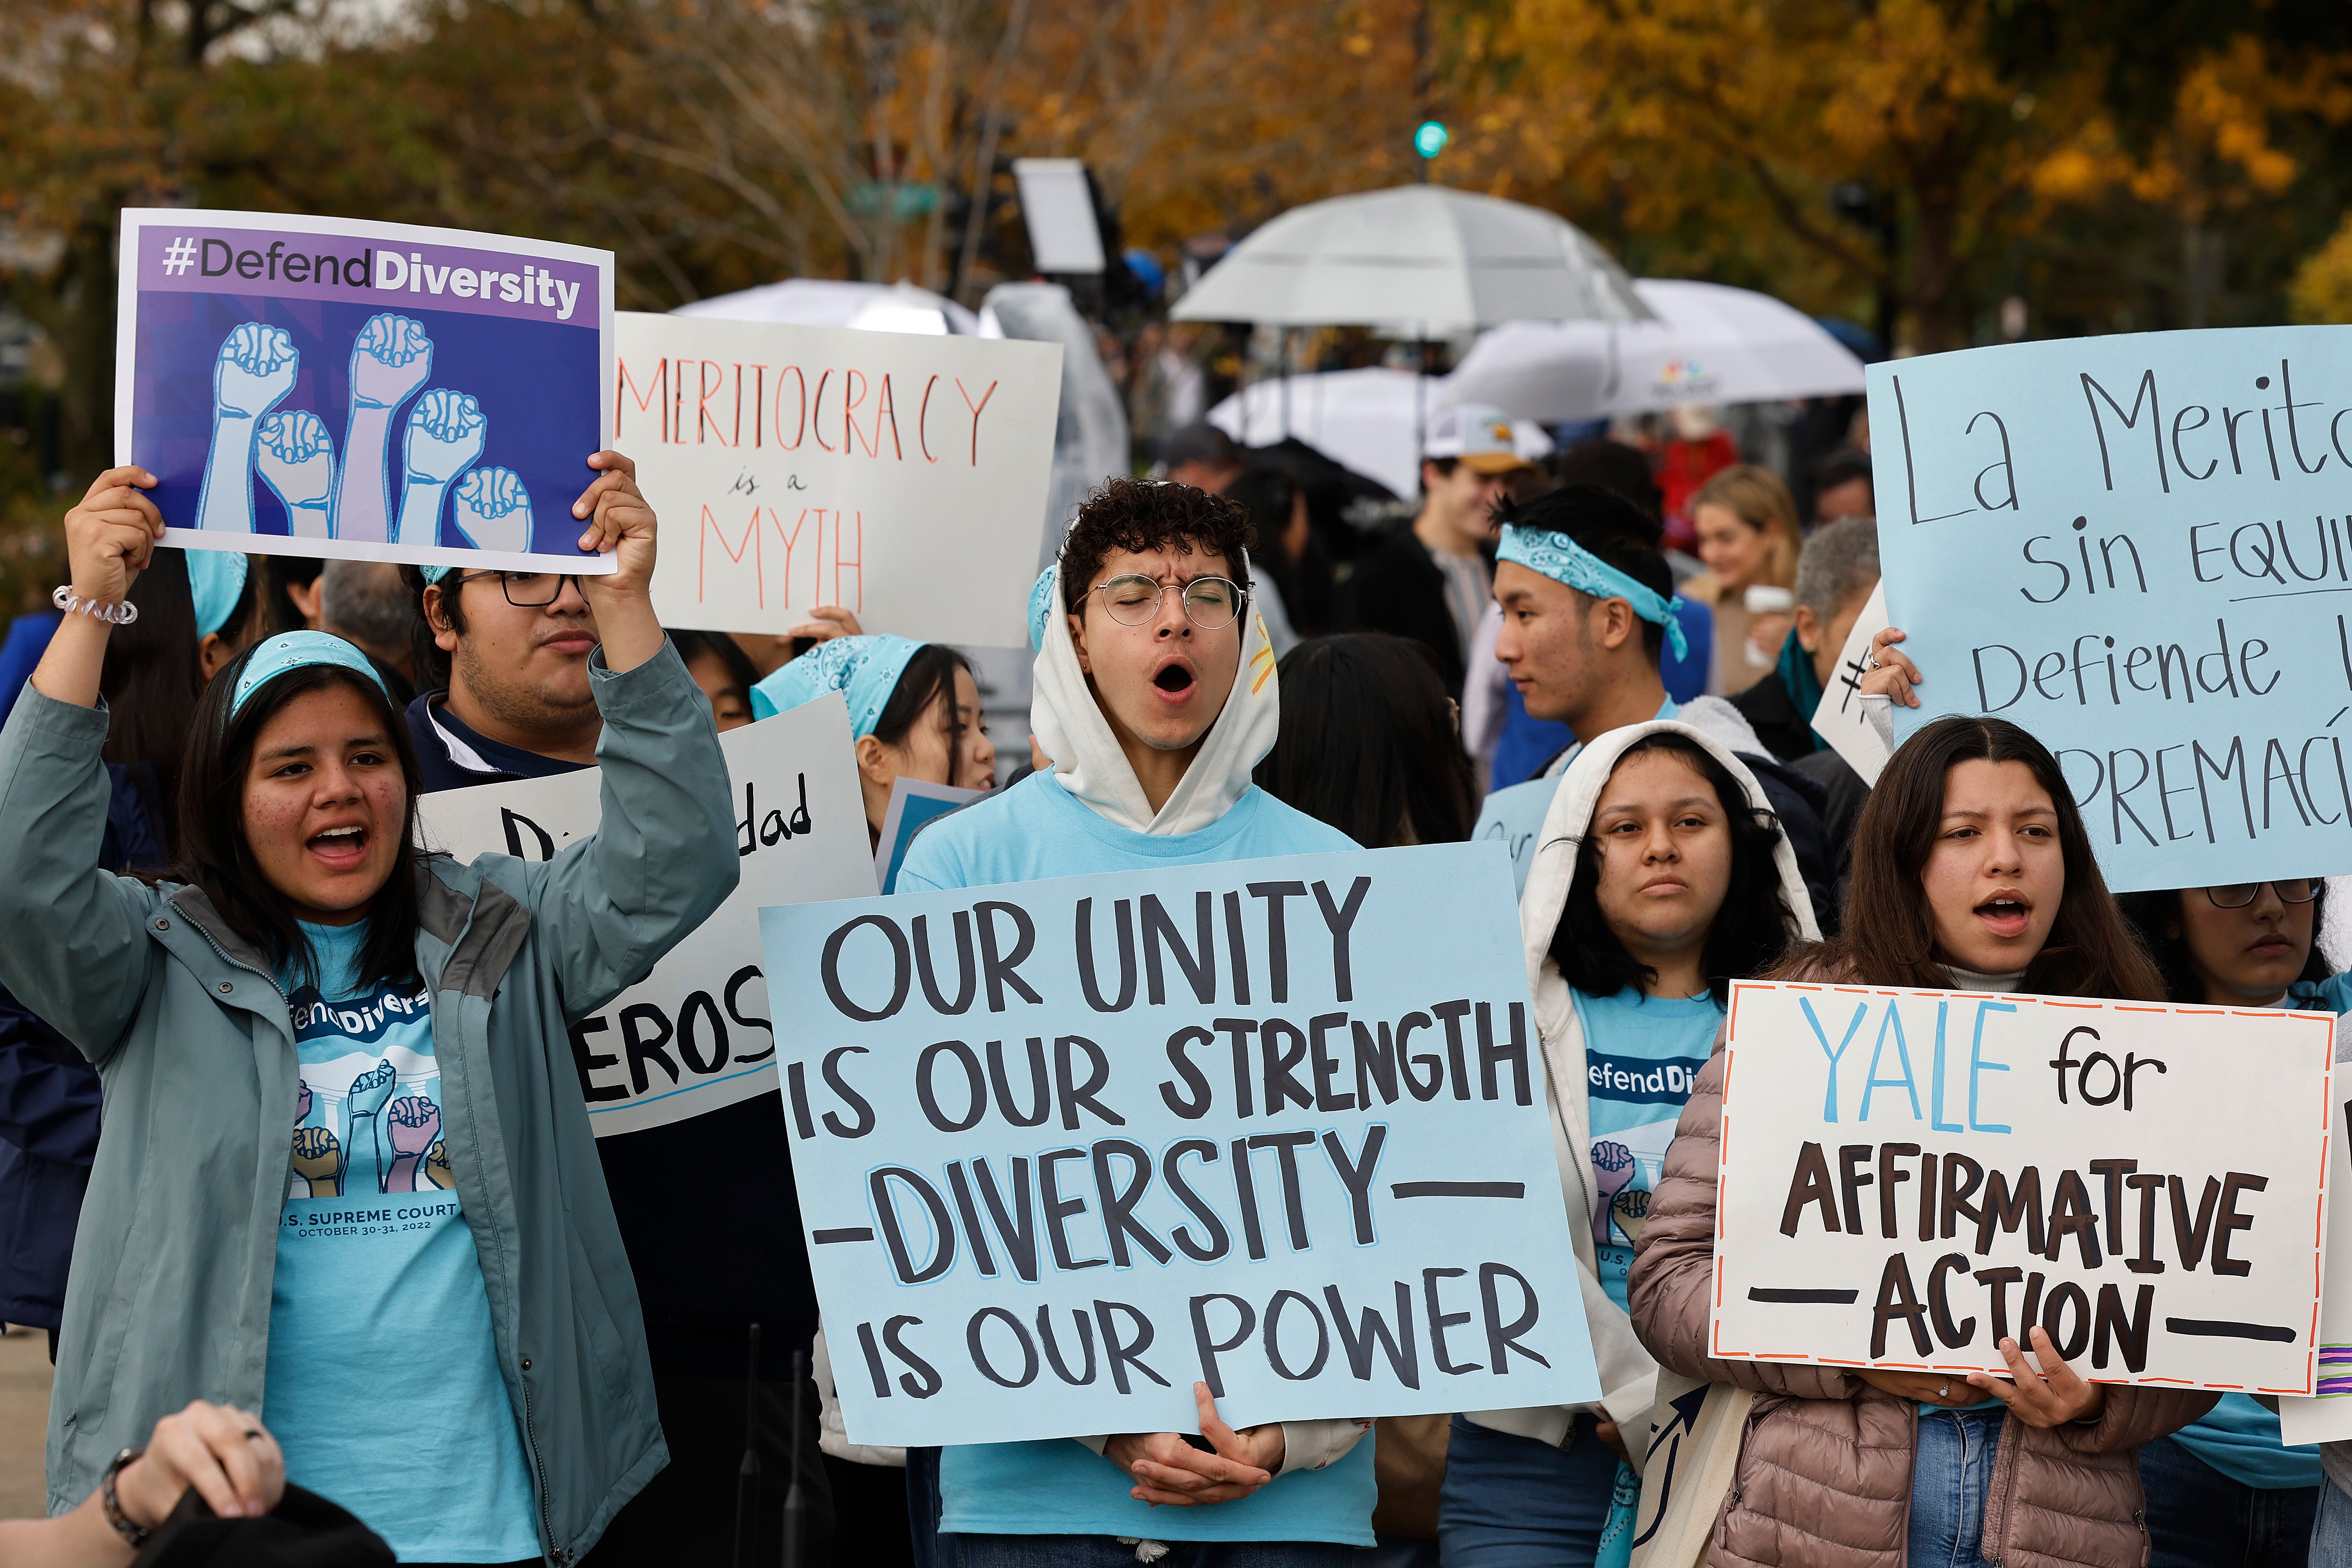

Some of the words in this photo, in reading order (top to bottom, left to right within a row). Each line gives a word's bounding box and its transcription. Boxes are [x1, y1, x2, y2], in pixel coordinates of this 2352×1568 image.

[162, 236, 581, 320] #DefendDiversity
[615, 357, 997, 466] MERITOCRACY
[1893, 375, 2019, 525] La
[727, 465, 760, 495] is
[787, 474, 808, 491] a
[699, 503, 862, 614] MYTH
[2020, 516, 2148, 603] sin
[1972, 618, 2281, 713] Defiende
[820, 901, 1043, 1022] OUR
[1075, 876, 1371, 1013] UNITY
[787, 1046, 876, 1140] IS
[916, 1035, 1126, 1133] OUR
[1158, 999, 1533, 1120] STRENGTH
[1588, 1062, 1697, 1094] efendDi
[1799, 996, 2017, 1134] YALE
[2049, 1026, 2167, 1112] for
[298, 1226, 357, 1237] OCTOBER
[362, 1225, 398, 1235] 30-31,
[404, 1221, 431, 1230] 2022
[309, 1209, 392, 1226] SUPREME
[397, 1203, 457, 1220] COURT
[1600, 1250, 1626, 1266] U.S.
[1779, 1141, 2270, 1277] AFFIRMATIVE
[856, 1315, 943, 1398] IS
[966, 1299, 1172, 1395] OUR
[1189, 1261, 1551, 1400] POWER
[1870, 1252, 2155, 1374] ACTION
